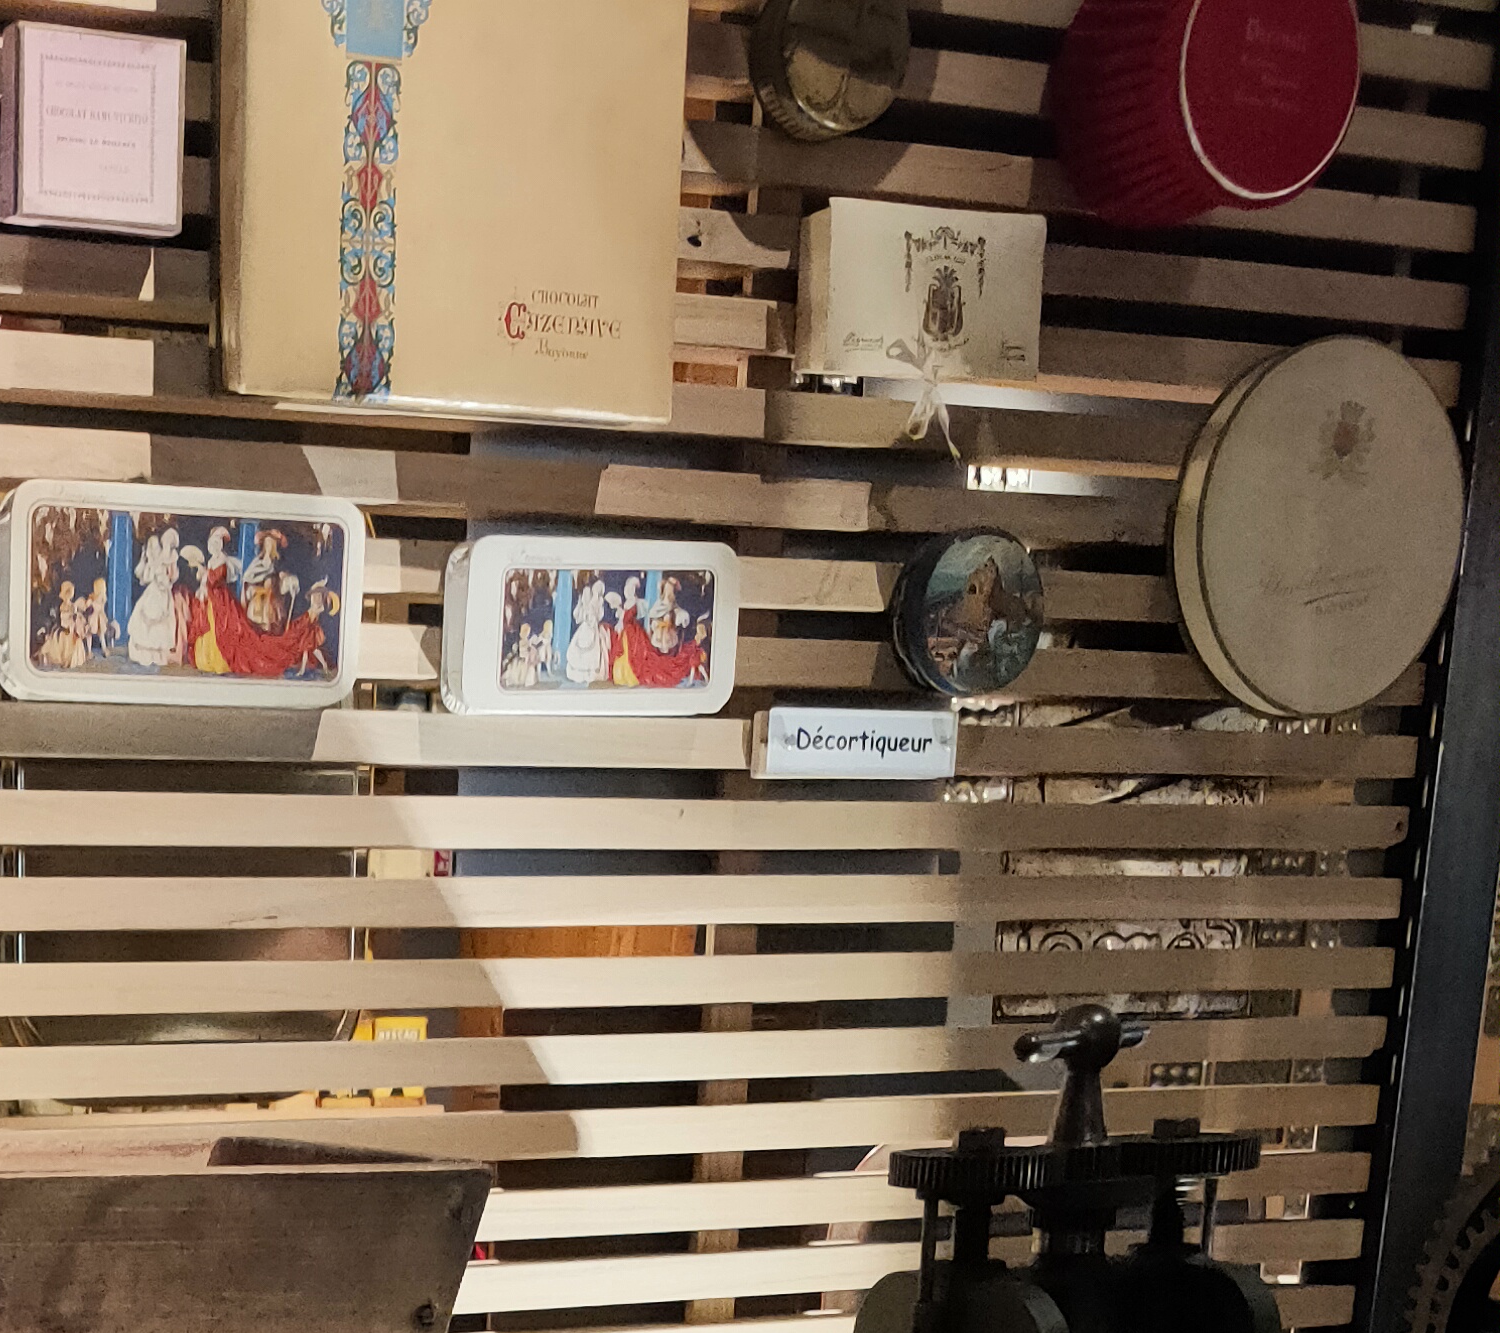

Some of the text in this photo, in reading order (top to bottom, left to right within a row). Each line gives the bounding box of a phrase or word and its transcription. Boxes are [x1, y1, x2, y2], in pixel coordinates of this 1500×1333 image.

[531, 289, 599, 308] CHOCOLAT
[534, 338, 589, 361] Bayonne
[796, 725, 933, 760] Décortiqueur
